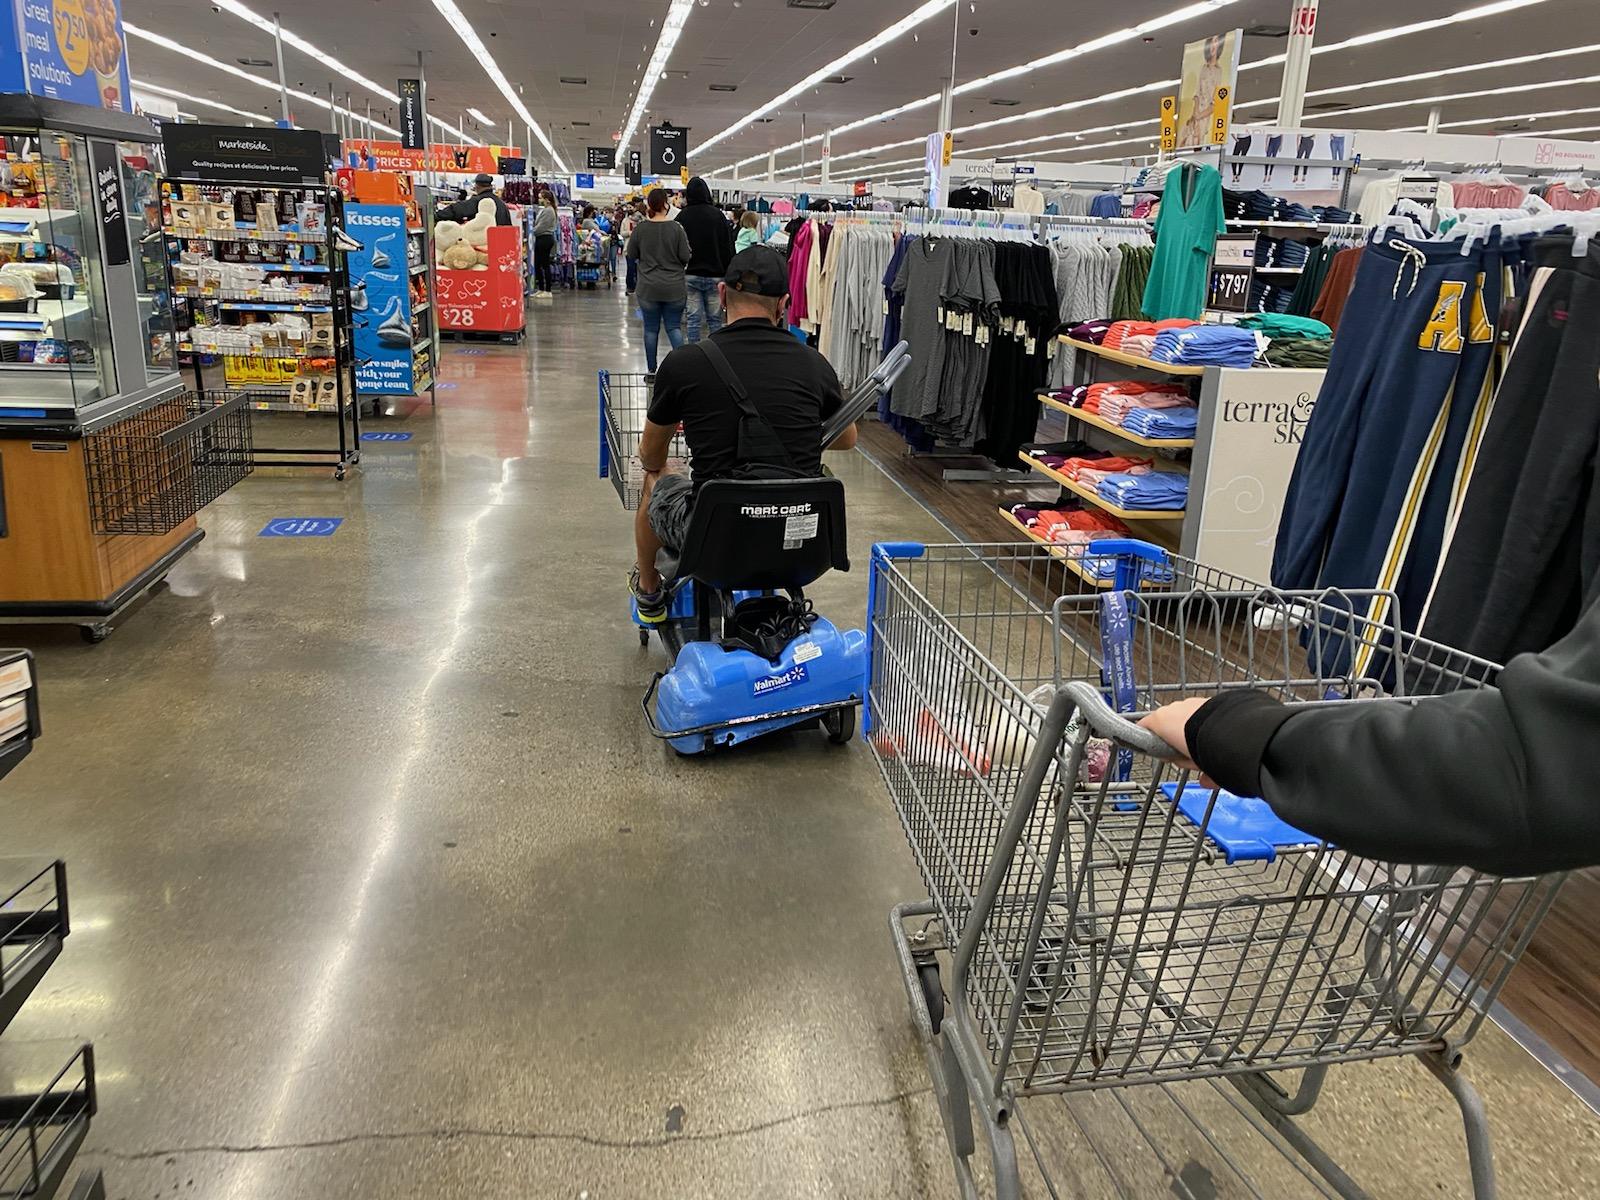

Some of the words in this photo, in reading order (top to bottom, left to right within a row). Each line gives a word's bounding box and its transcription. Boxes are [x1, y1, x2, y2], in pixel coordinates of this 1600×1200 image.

[24, 0, 51, 24] Great
[26, 31, 50, 52] meal
[30, 59, 72, 86] solutions
[405, 97, 414, 120] Money
[1216, 118, 1224, 129] B
[407, 120, 416, 147] Services
[1164, 127, 1171, 136] B
[1214, 133, 1225, 142] 12
[1163, 140, 1172, 148] 13
[192, 160, 213, 168] Quality
[241, 163, 270, 171] deliciously
[442, 308, 474, 326] $28
[1418, 280, 1467, 354] A
[381, 359, 409, 369] smiles
[356, 369, 378, 380] with
[378, 372, 402, 380] your
[356, 379, 382, 389] home
[384, 380, 409, 390] team
